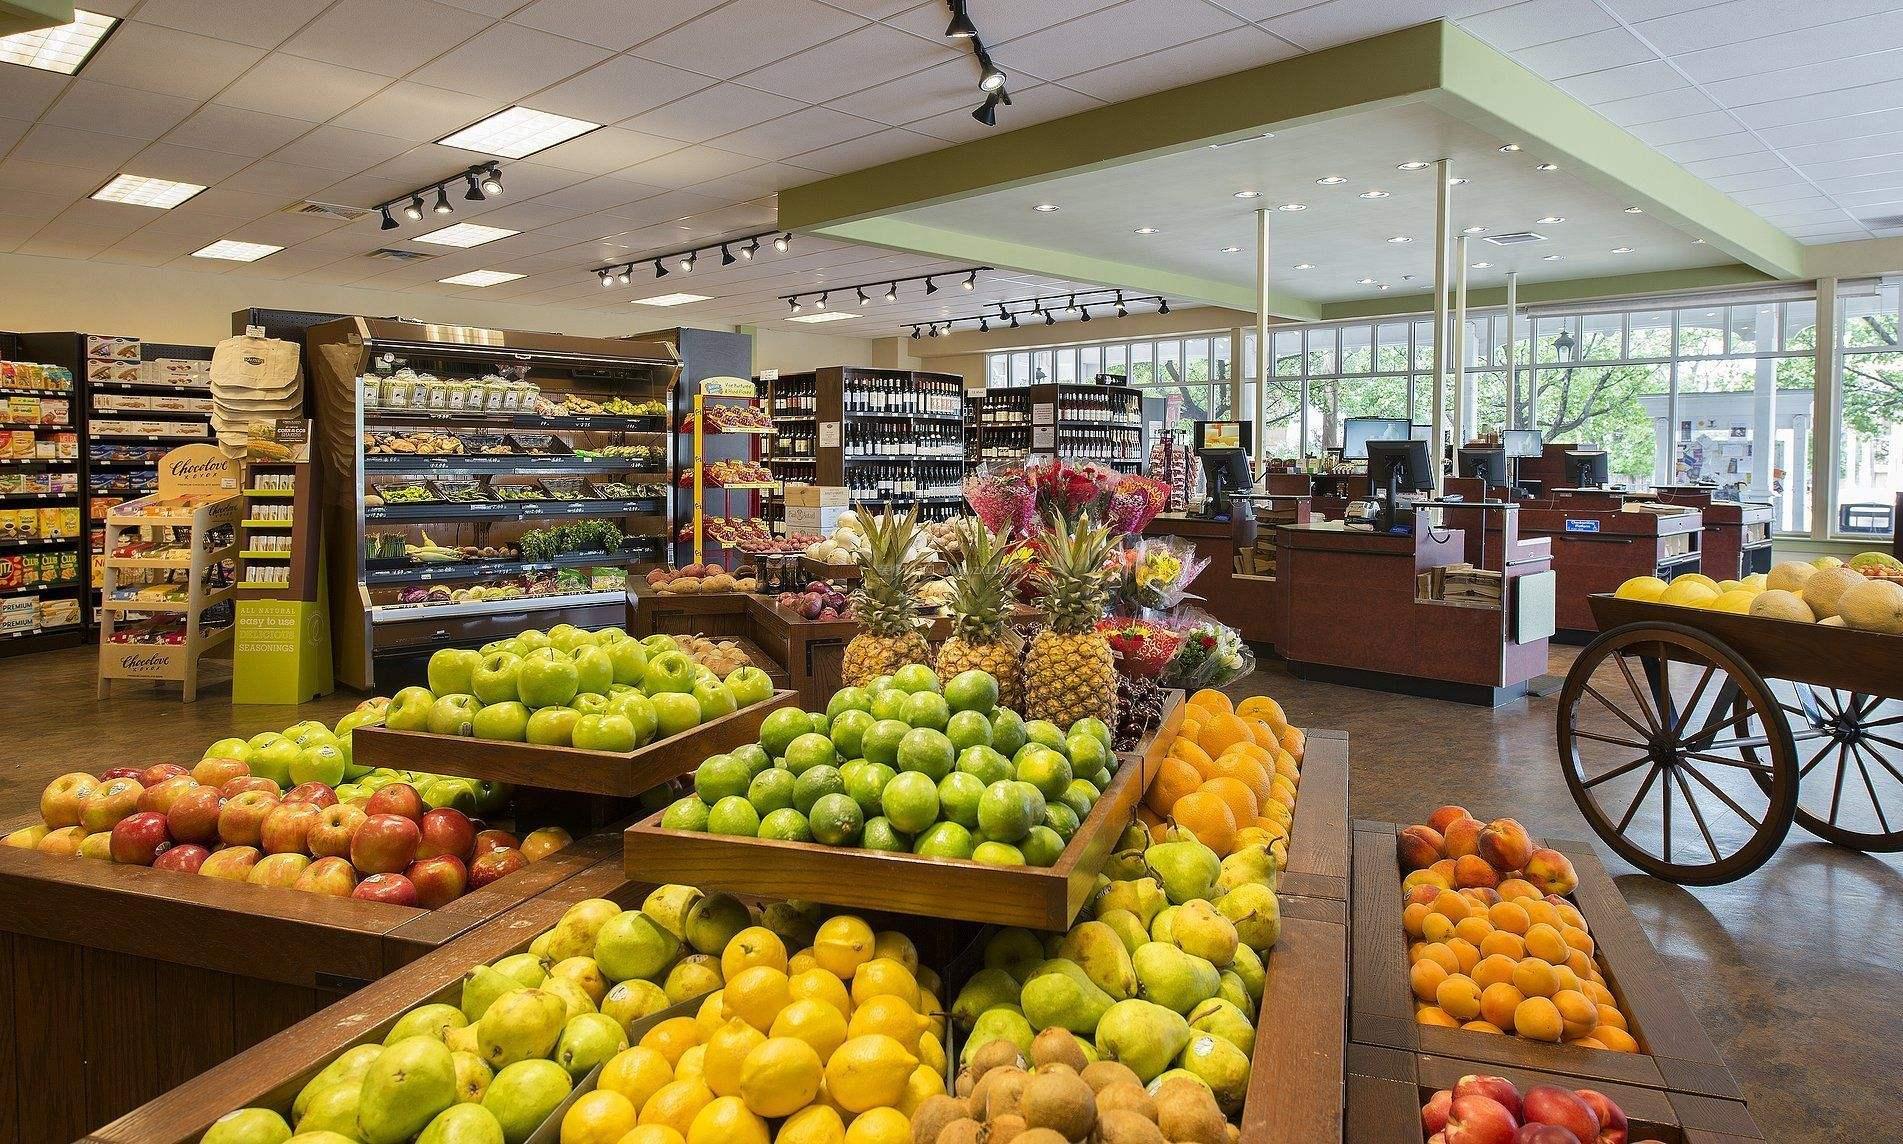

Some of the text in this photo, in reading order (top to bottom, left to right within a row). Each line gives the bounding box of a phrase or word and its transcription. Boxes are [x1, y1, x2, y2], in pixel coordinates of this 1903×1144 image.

[169, 457, 228, 477] Chocolove
[2, 602, 33, 612] PREMIUM
[258, 607, 296, 615] NATURAL
[2, 619, 33, 629] PREMIUM
[239, 617, 295, 628] easy to use
[239, 643, 295, 653] SEASONINGS
[120, 652, 170, 669] Chocolove
